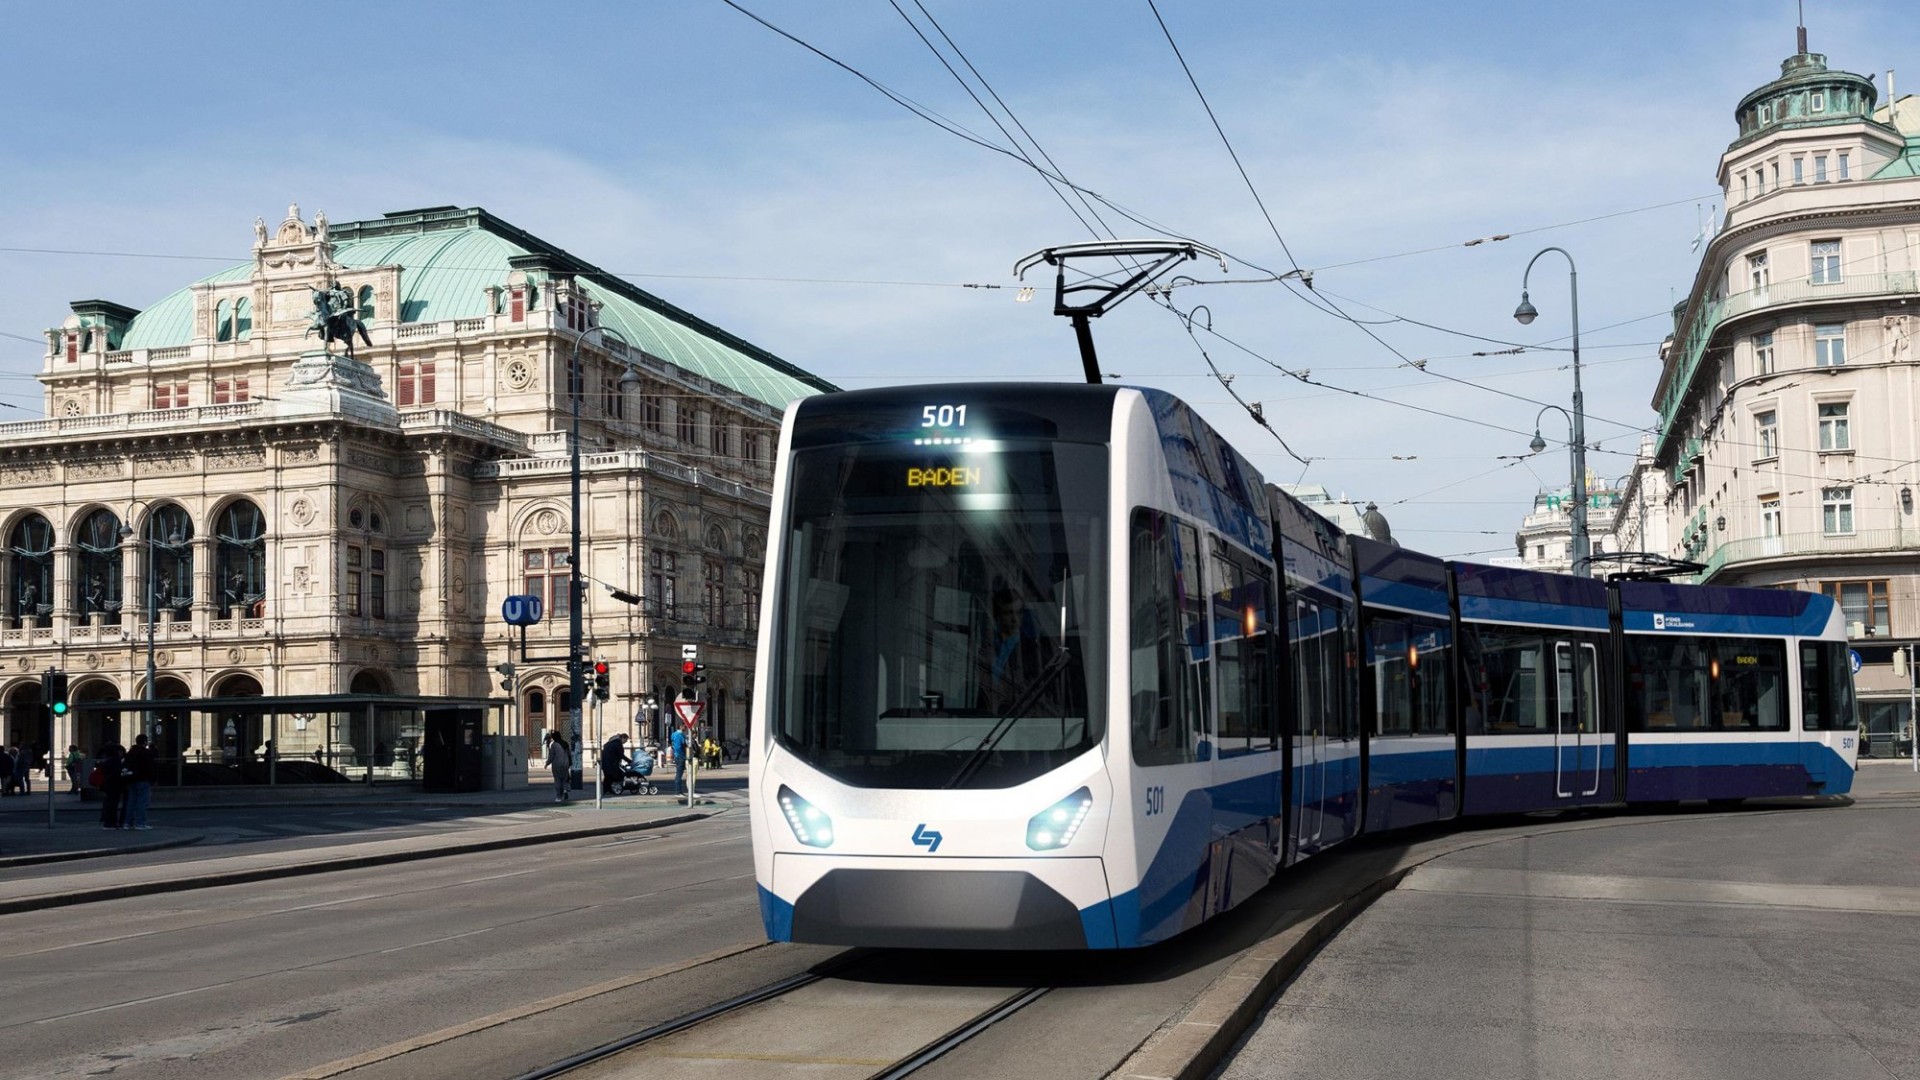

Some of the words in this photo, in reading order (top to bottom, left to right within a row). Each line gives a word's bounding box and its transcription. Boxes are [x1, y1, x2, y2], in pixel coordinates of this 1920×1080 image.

[921, 405, 966, 427] 501
[908, 467, 980, 487] BADEN
[505, 600, 522, 621] U
[529, 600, 541, 621] U
[1843, 738, 1854, 749] 501
[1146, 785, 1164, 816] 501
